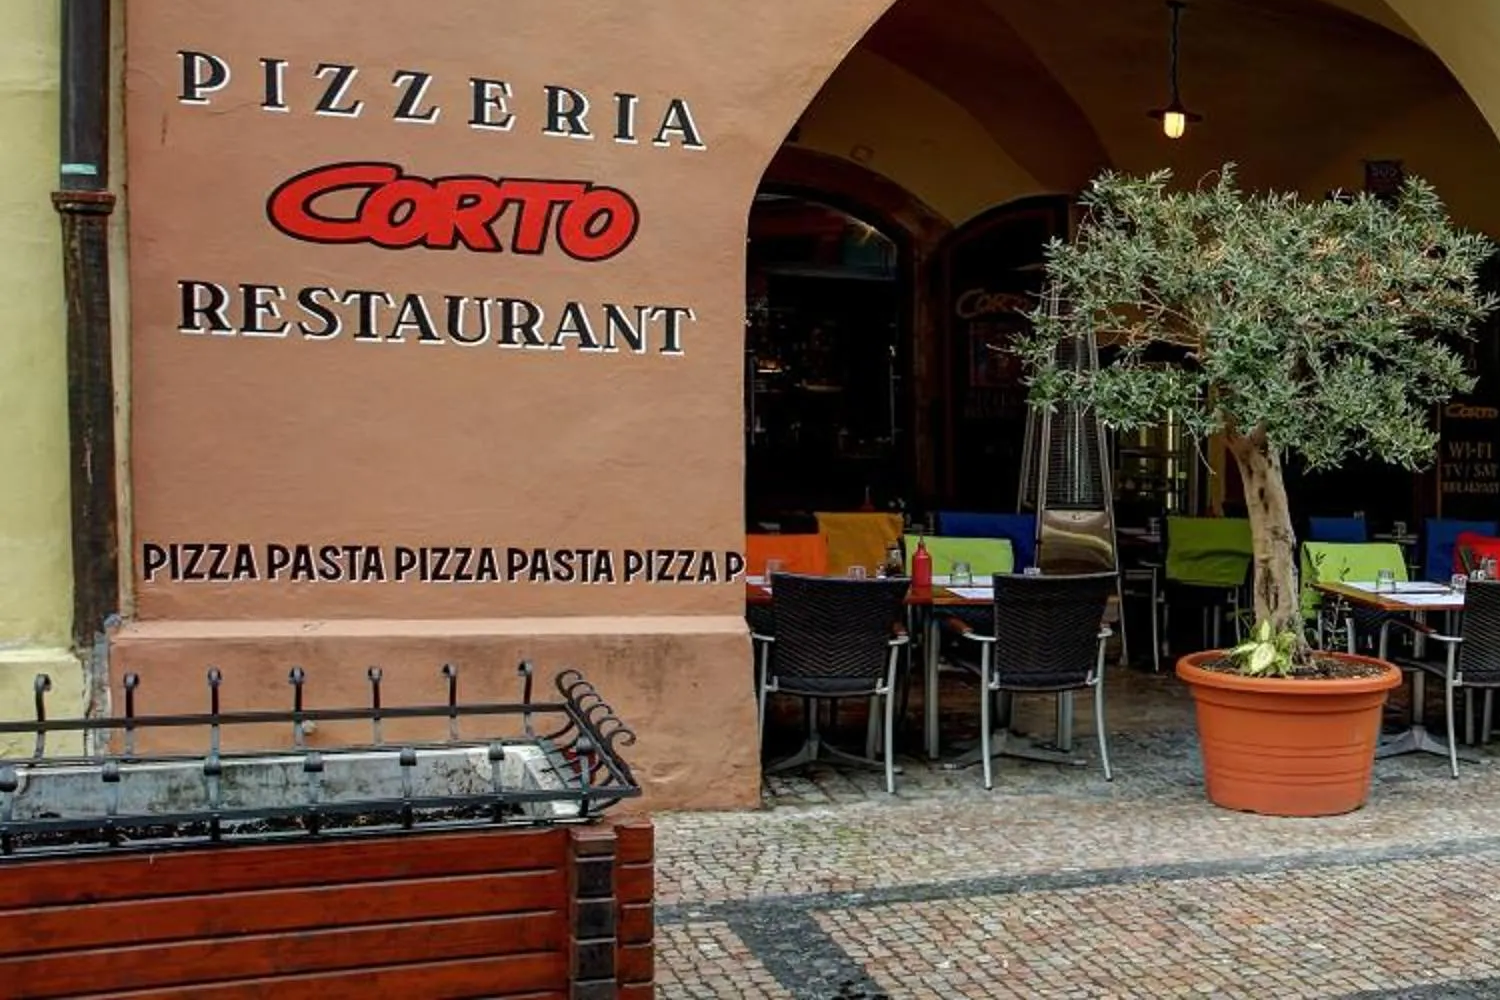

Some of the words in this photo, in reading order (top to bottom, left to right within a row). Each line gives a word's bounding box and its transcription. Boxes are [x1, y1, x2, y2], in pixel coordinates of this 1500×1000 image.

[177, 50, 707, 149] PIZZERIA
[266, 161, 640, 262] CORTO
[177, 279, 696, 355] RESTAURANT
[1448, 440, 1492, 459] WI-FI
[143, 543, 260, 583] PIZZA
[267, 544, 387, 583] PASTA
[395, 546, 501, 583] PIZZA
[507, 547, 616, 584] PASTA
[623, 549, 720, 585] PIZZA
